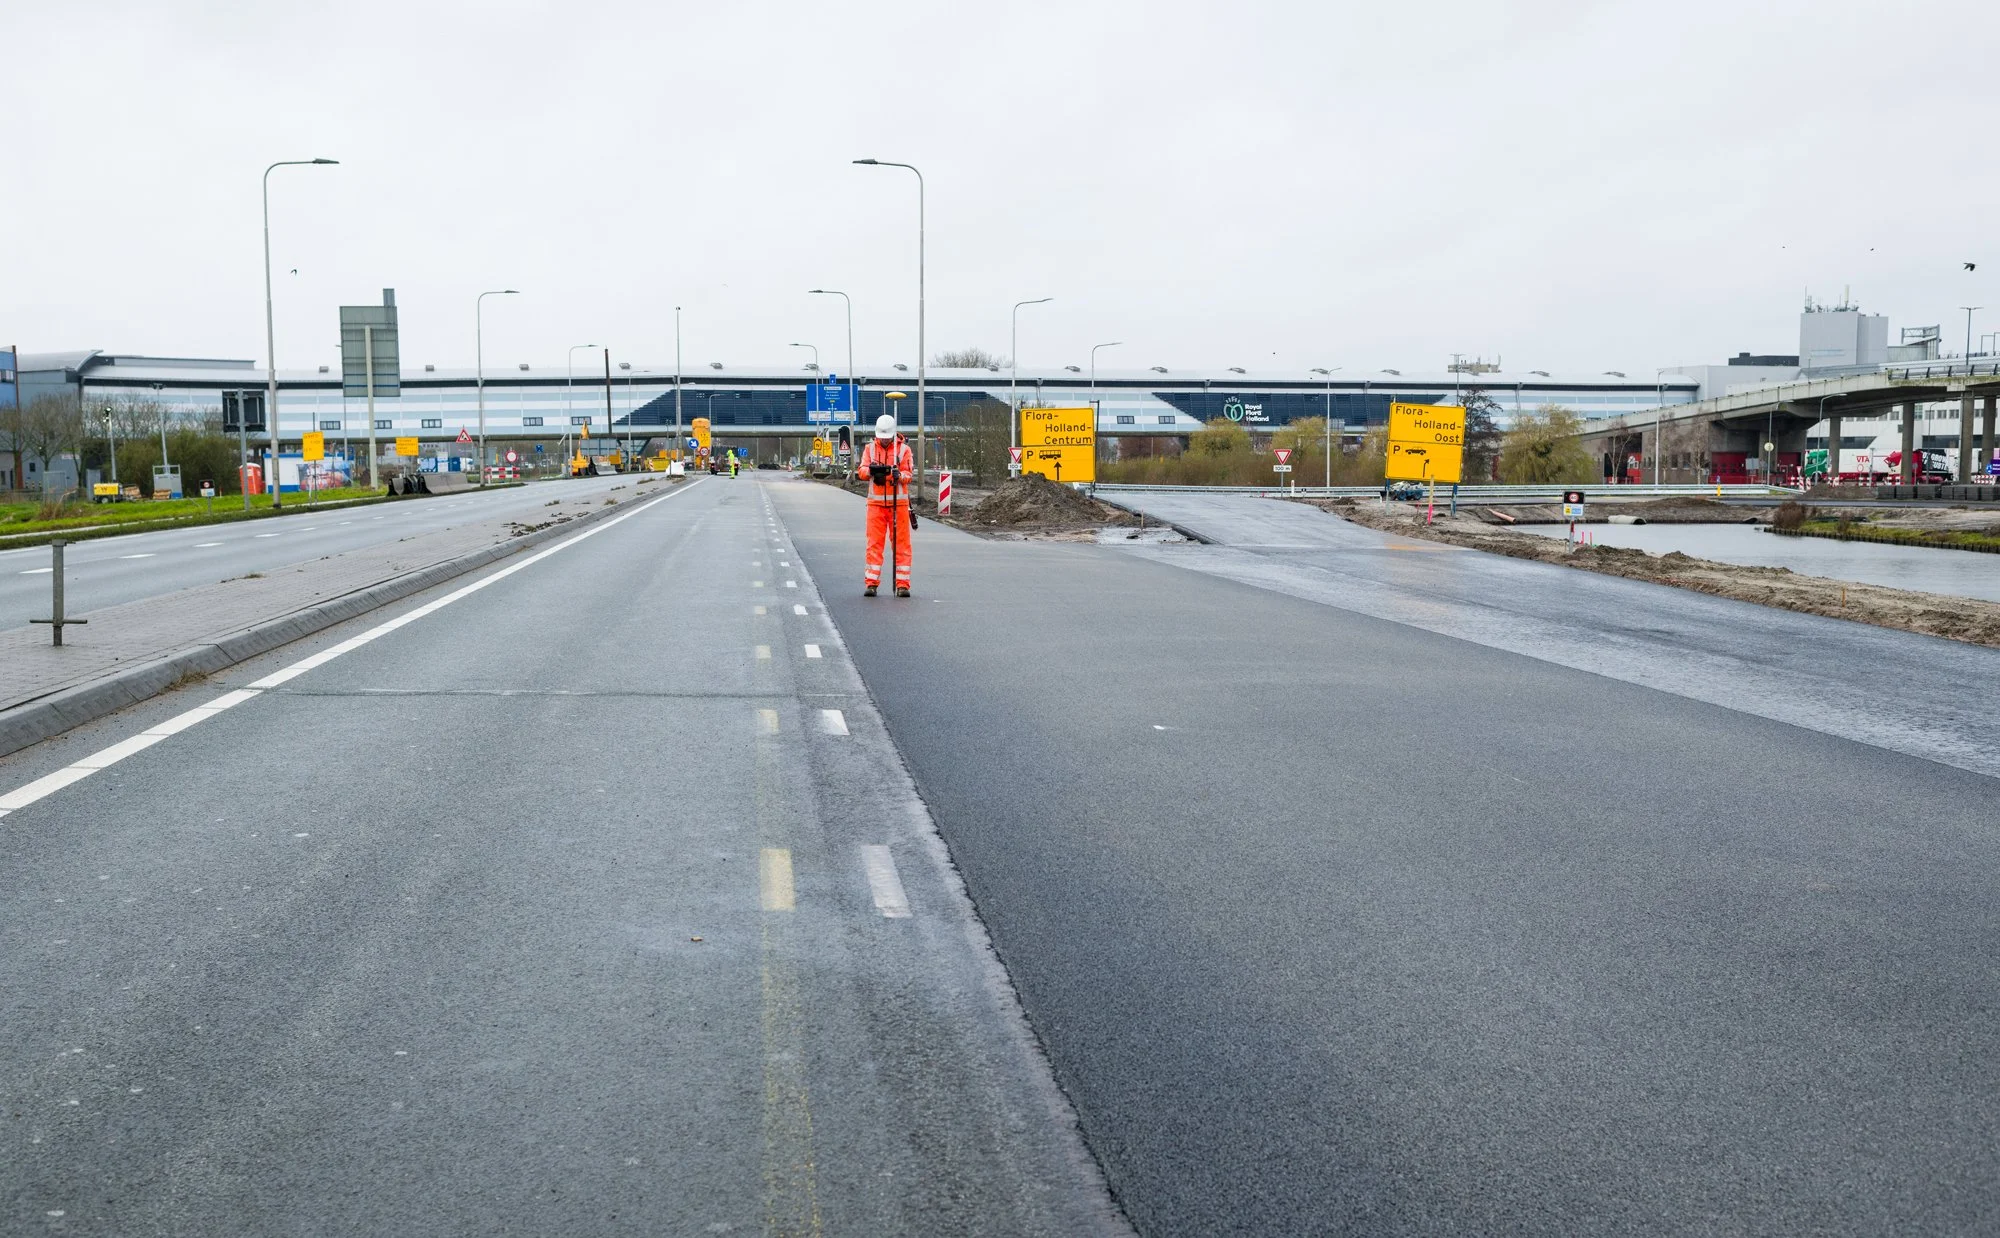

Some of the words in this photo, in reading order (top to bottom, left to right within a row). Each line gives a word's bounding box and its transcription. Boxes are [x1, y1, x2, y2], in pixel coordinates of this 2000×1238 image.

[1395, 406, 1429, 415] Flora-
[1025, 411, 1059, 420] Flora-
[1045, 423, 1092, 432] Holland-
[1414, 420, 1461, 430] Holland-
[1044, 436, 1092, 445] Centrum
[1434, 433, 1459, 443] Oost
[1393, 445, 1400, 454] P
[1026, 450, 1034, 459] P
